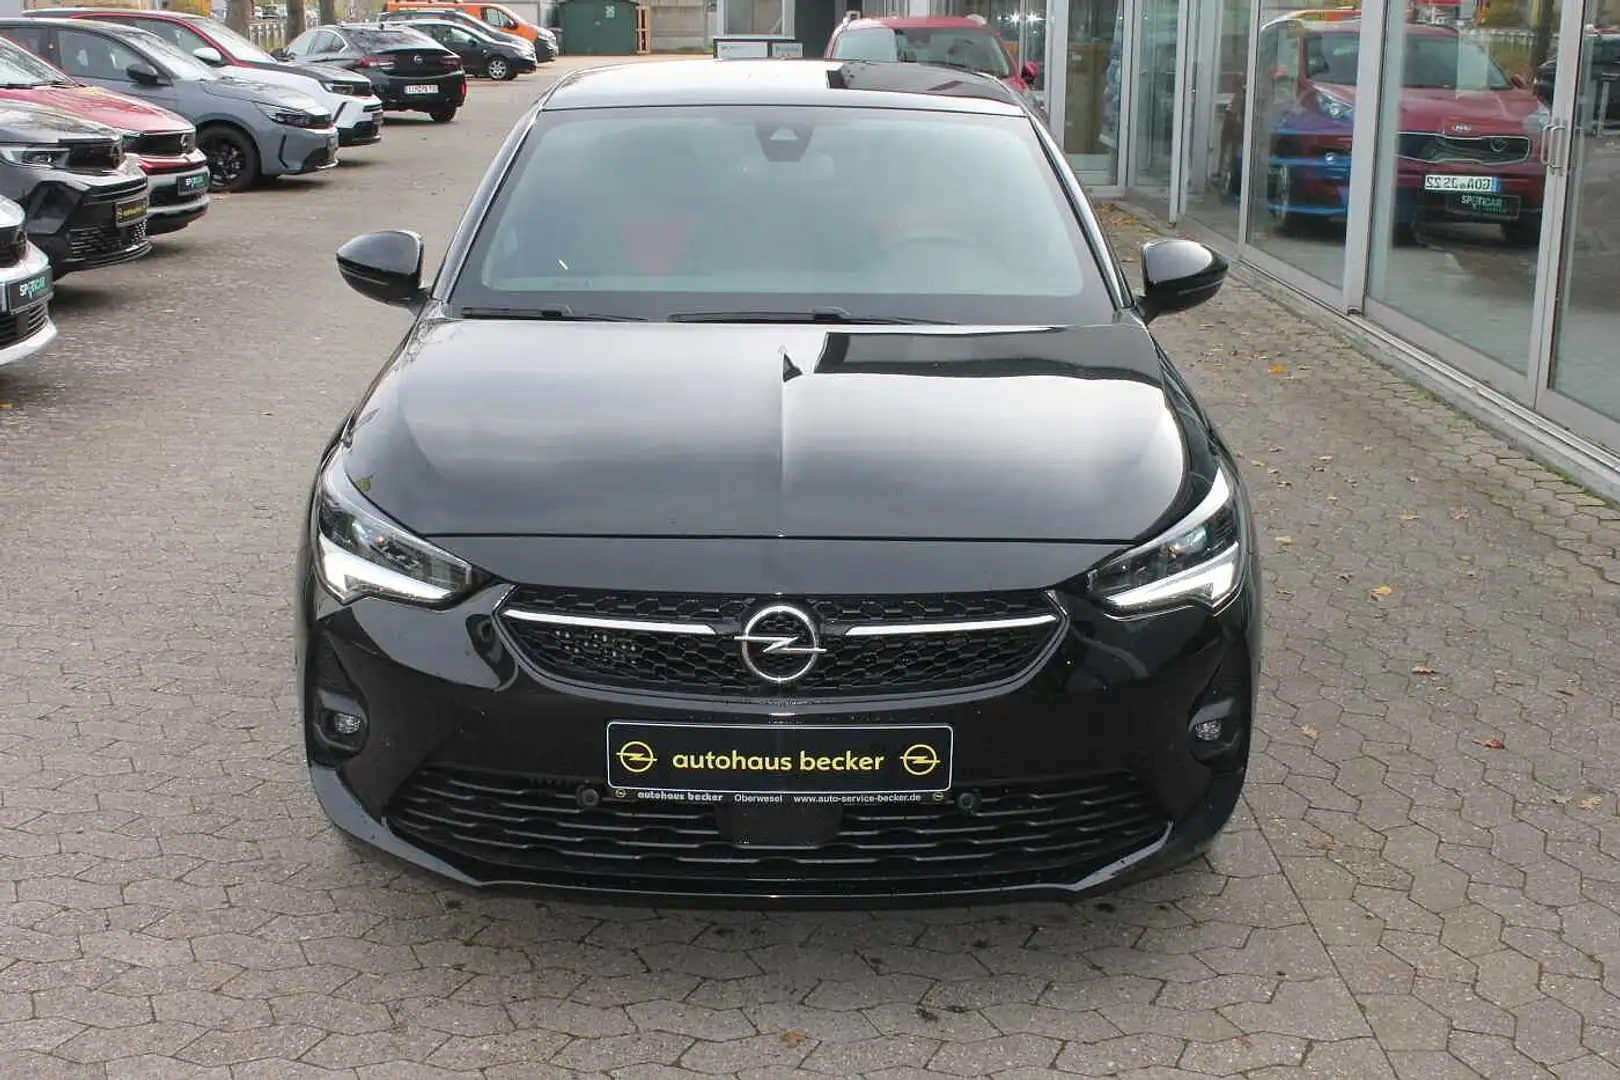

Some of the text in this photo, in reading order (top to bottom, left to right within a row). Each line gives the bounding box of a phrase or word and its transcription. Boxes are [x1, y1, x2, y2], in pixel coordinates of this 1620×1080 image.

[672, 750, 885, 771] autohaus becker
[637, 790, 921, 804] autohaus becker Oberwesel www.auto-service-becker.de
